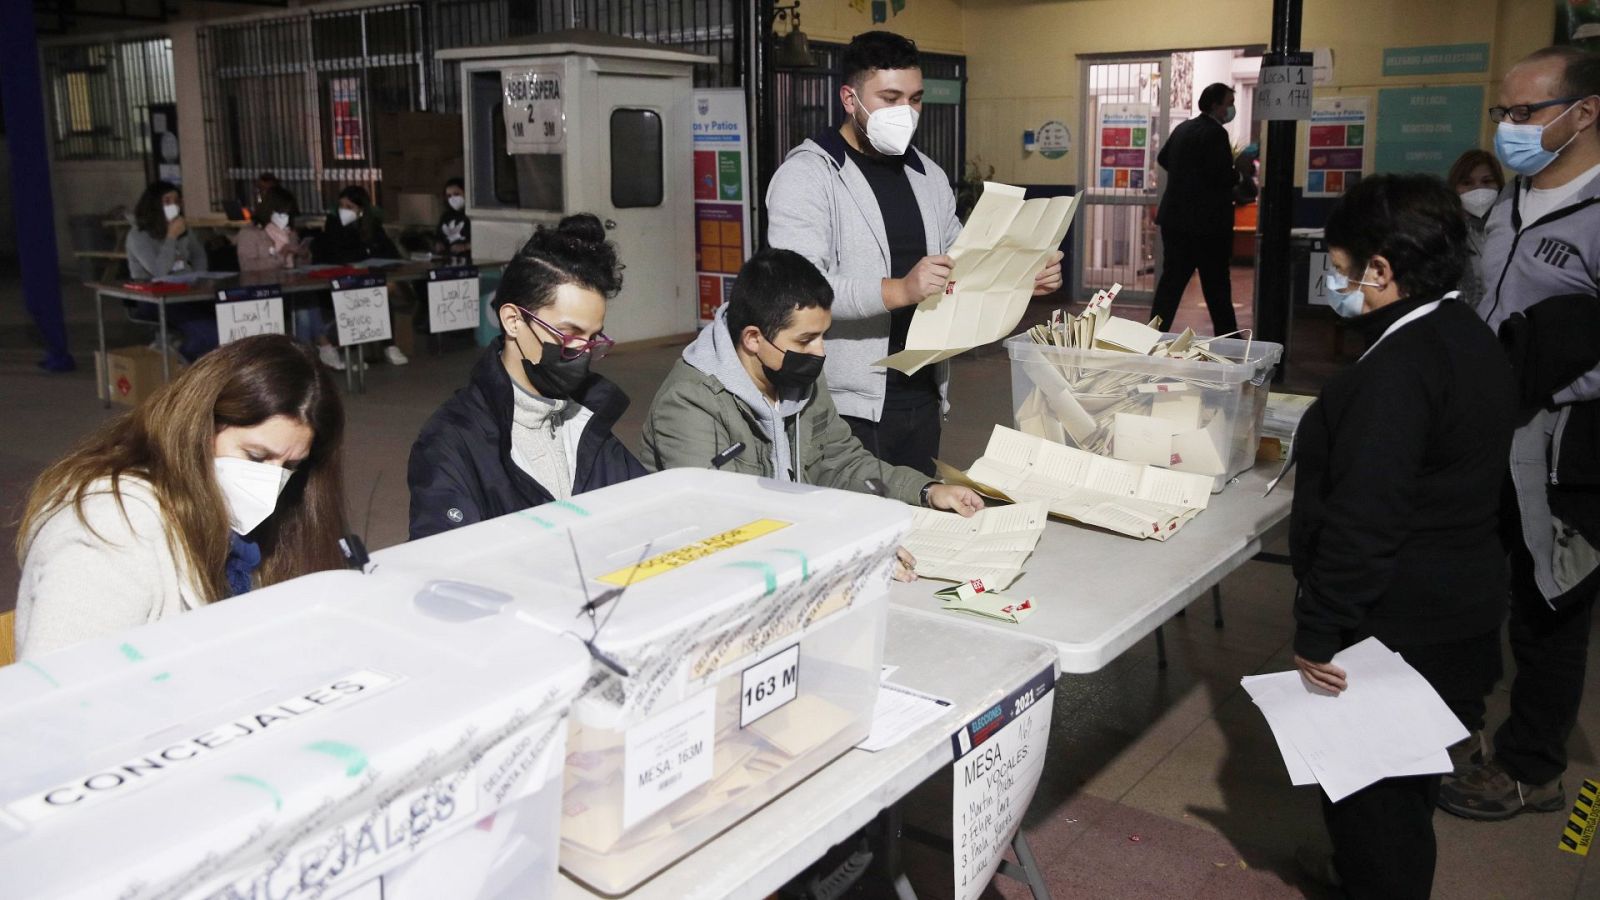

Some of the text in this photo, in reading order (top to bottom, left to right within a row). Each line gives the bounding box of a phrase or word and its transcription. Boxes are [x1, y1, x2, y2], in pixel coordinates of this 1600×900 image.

[1295, 67, 1307, 85] 1
[529, 79, 560, 101] ESPERA
[527, 103, 535, 124] 2
[512, 121, 556, 137] 1M 3M
[704, 123, 709, 132] y
[711, 120, 738, 131] Patios
[462, 281, 470, 299] 2
[263, 300, 271, 319] 1
[743, 664, 796, 707] 163 M
[1014, 688, 1035, 716] 2021
[43, 678, 366, 807] CONCEJALES
[638, 758, 675, 788] MESA:
[677, 739, 704, 765] 163M
[964, 742, 1002, 788] MESA
[961, 833, 967, 849] 2
[961, 853, 968, 869] 3
[961, 874, 967, 888] 4
